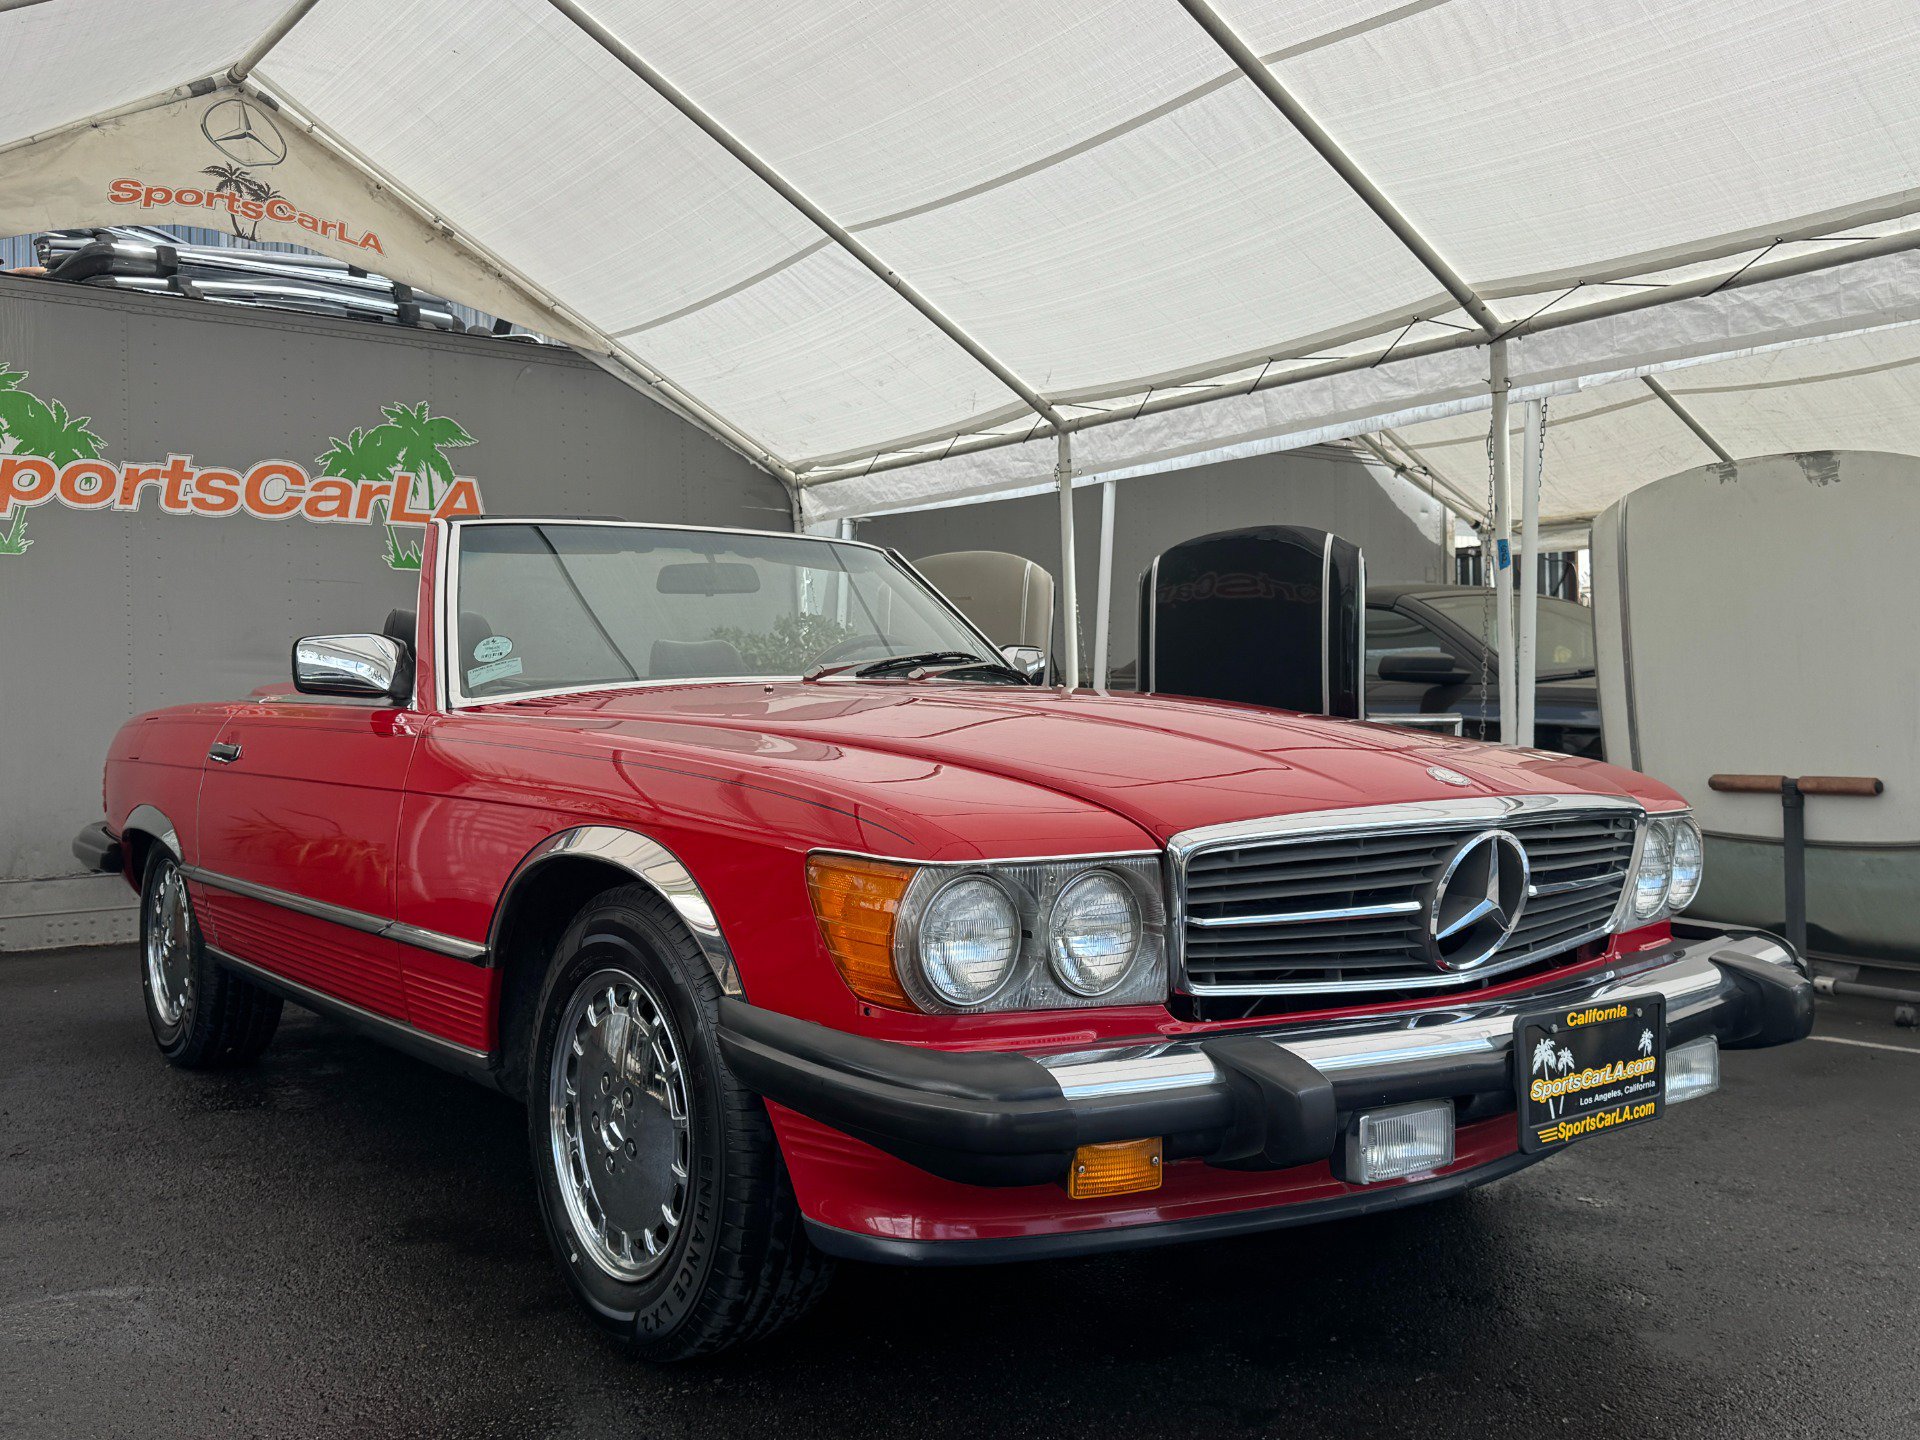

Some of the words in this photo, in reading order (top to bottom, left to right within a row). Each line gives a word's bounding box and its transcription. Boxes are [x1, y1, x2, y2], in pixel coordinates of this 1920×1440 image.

[109, 179, 383, 254] SportsCarLA
[0, 458, 481, 523] portsCarLA
[1567, 1005, 1627, 1026] California
[1531, 1057, 1655, 1103] SportsCarLA.com
[1579, 1096, 1593, 1106] Los
[1595, 1089, 1623, 1102] Angeles,
[1624, 1081, 1655, 1094] California
[1558, 1102, 1655, 1141] SportsCarLA.com
[673, 1156, 713, 1304] ENHANCE
[642, 1301, 672, 1333] LX2
